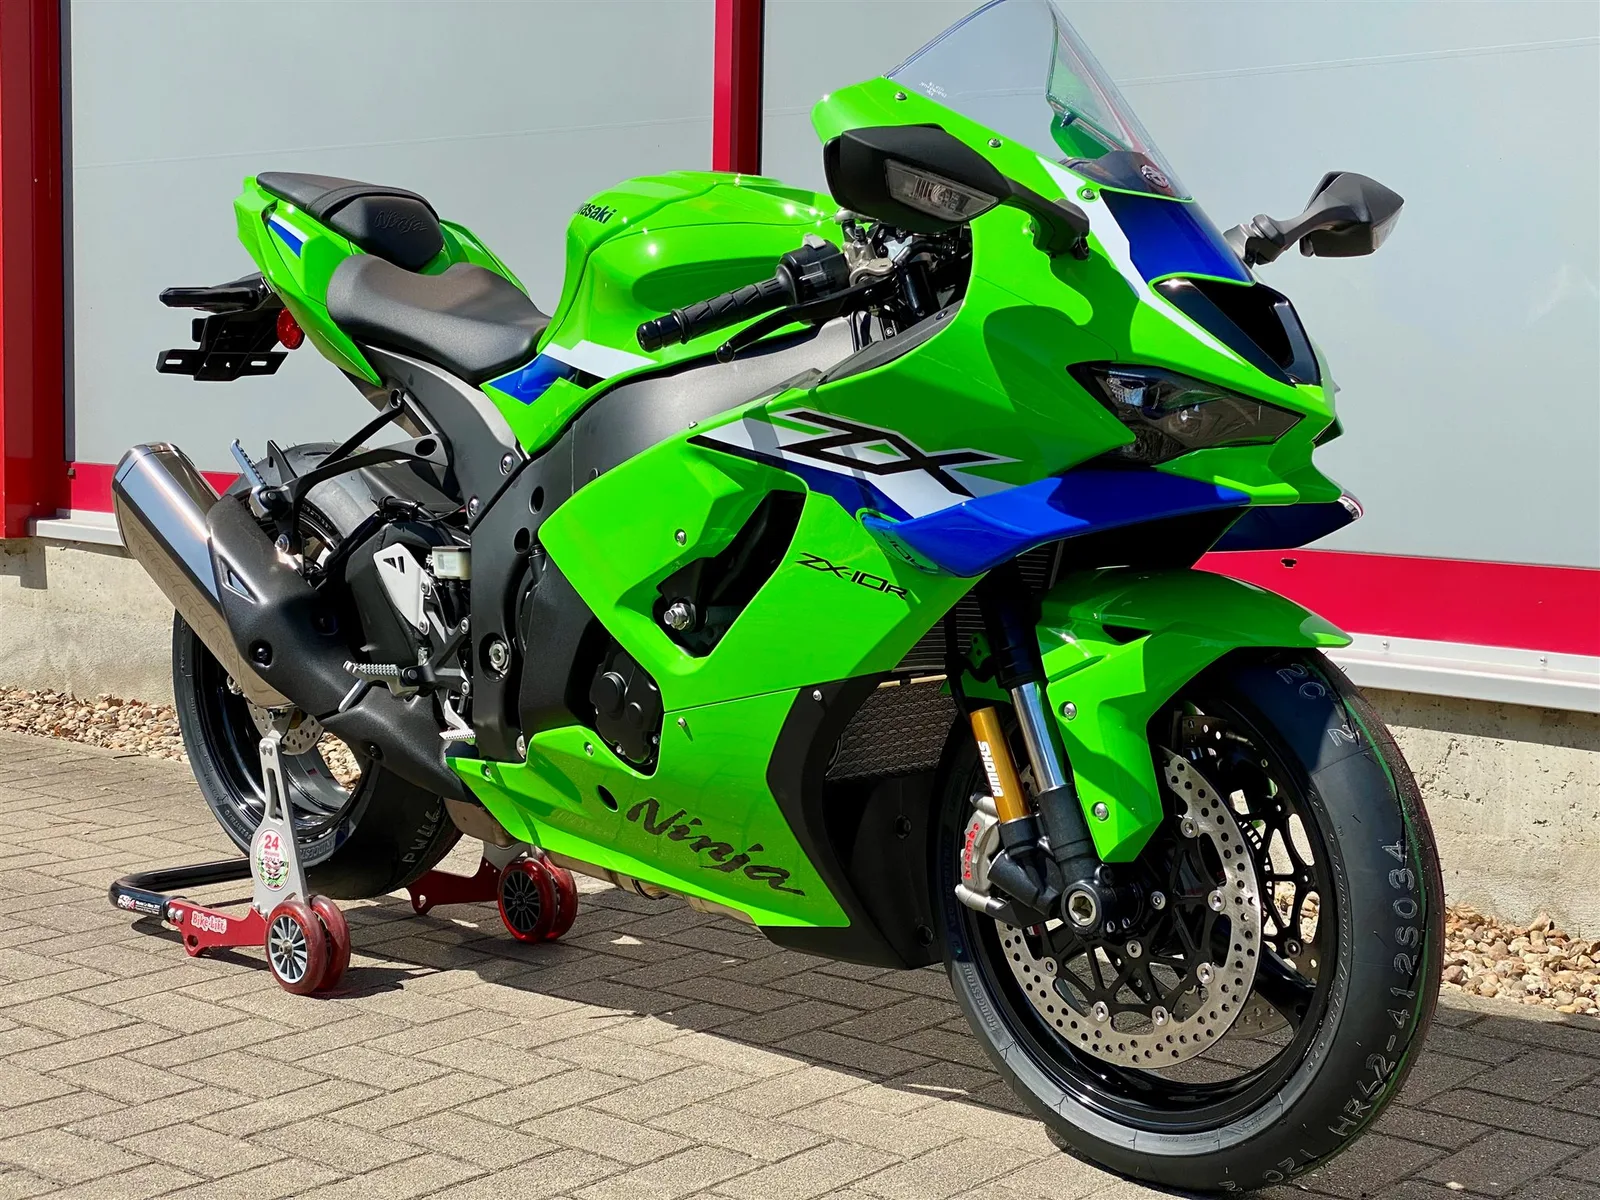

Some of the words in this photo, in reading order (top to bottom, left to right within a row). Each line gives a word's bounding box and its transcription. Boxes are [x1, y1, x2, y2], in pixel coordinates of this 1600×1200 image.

[374, 208, 429, 236] Ninja
[774, 409, 1002, 499] ZX
[796, 552, 909, 601] ZX-10R
[264, 834, 280, 851] 24
[626, 797, 806, 896] Ninja
